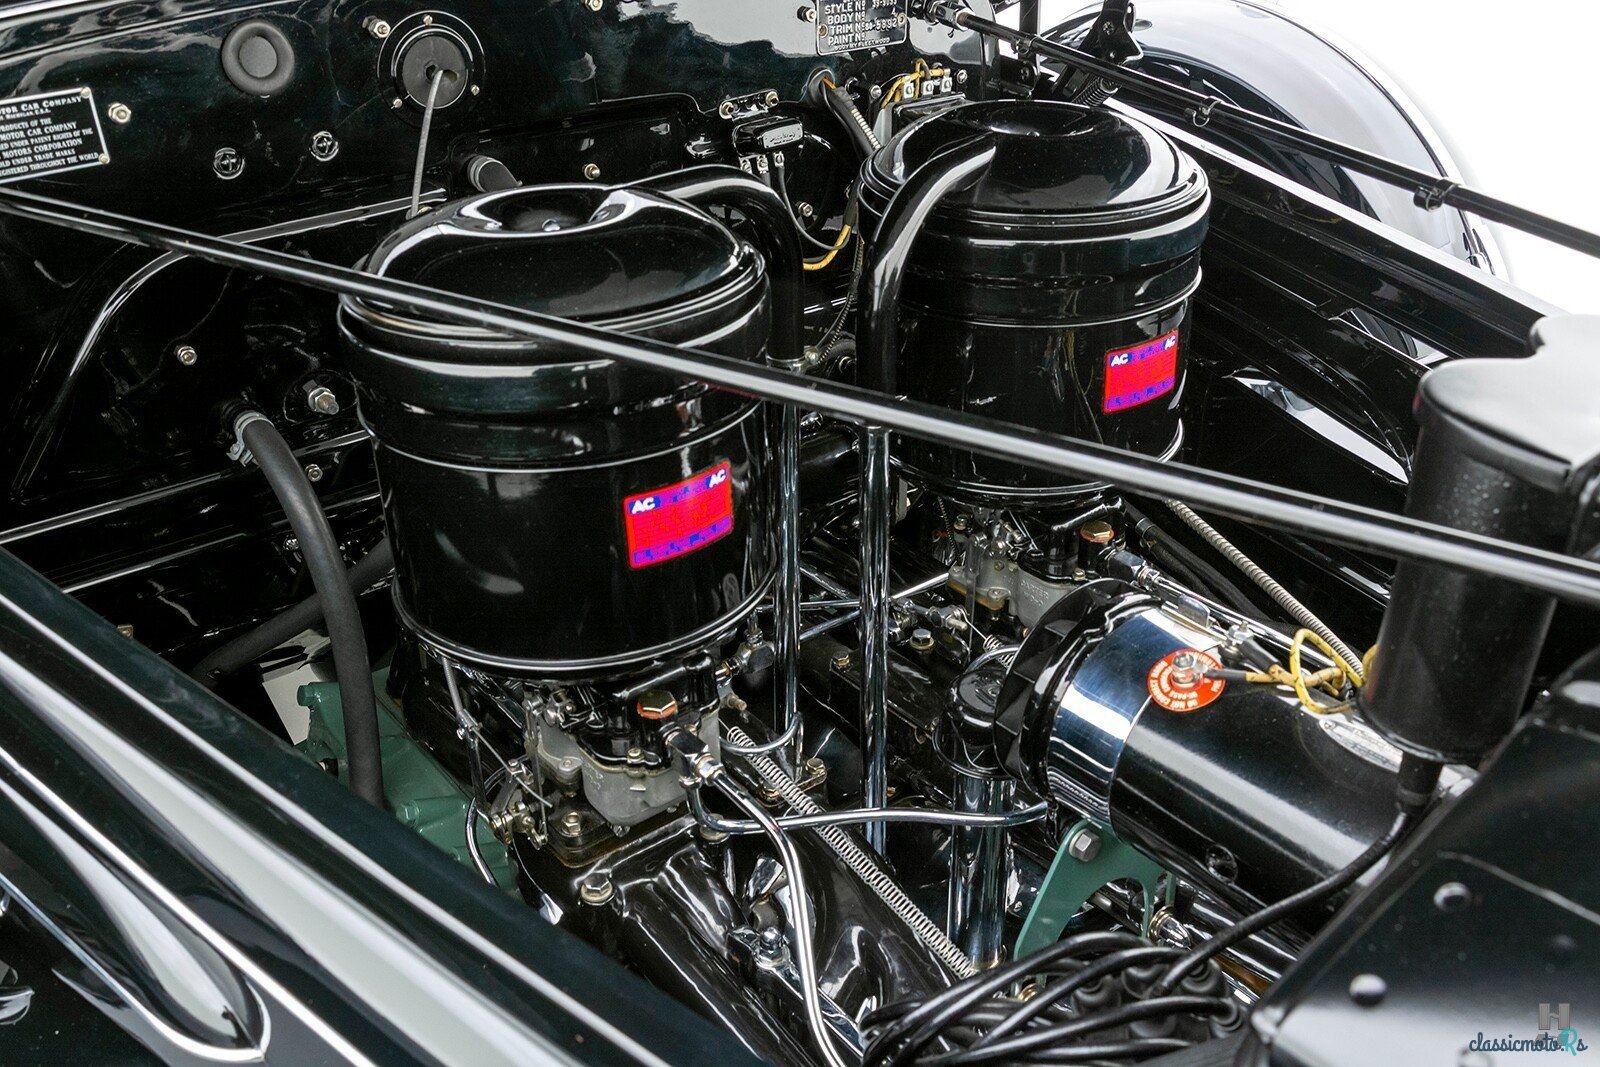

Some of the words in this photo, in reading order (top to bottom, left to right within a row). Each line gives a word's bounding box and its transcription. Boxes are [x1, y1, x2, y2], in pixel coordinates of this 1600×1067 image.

[825, 1, 853, 14] STYLE
[828, 12, 854, 24] BODY
[829, 23, 853, 35] TRIM
[828, 33, 854, 45] PAINT
[21, 102, 40, 111] CAR
[42, 95, 82, 108] COMPANY
[40, 117, 52, 126] THE
[27, 128, 42, 137] CAR
[44, 121, 77, 134] COMPANY
[2, 147, 32, 159] MOTORS
[34, 138, 82, 153] CORPORATION
[34, 152, 54, 161] TRADE
[79, 152, 99, 161] WORLD
[1163, 335, 1176, 350] AC
[1110, 353, 1129, 367] AC
[708, 469, 726, 488] AC
[631, 497, 656, 514] AC
